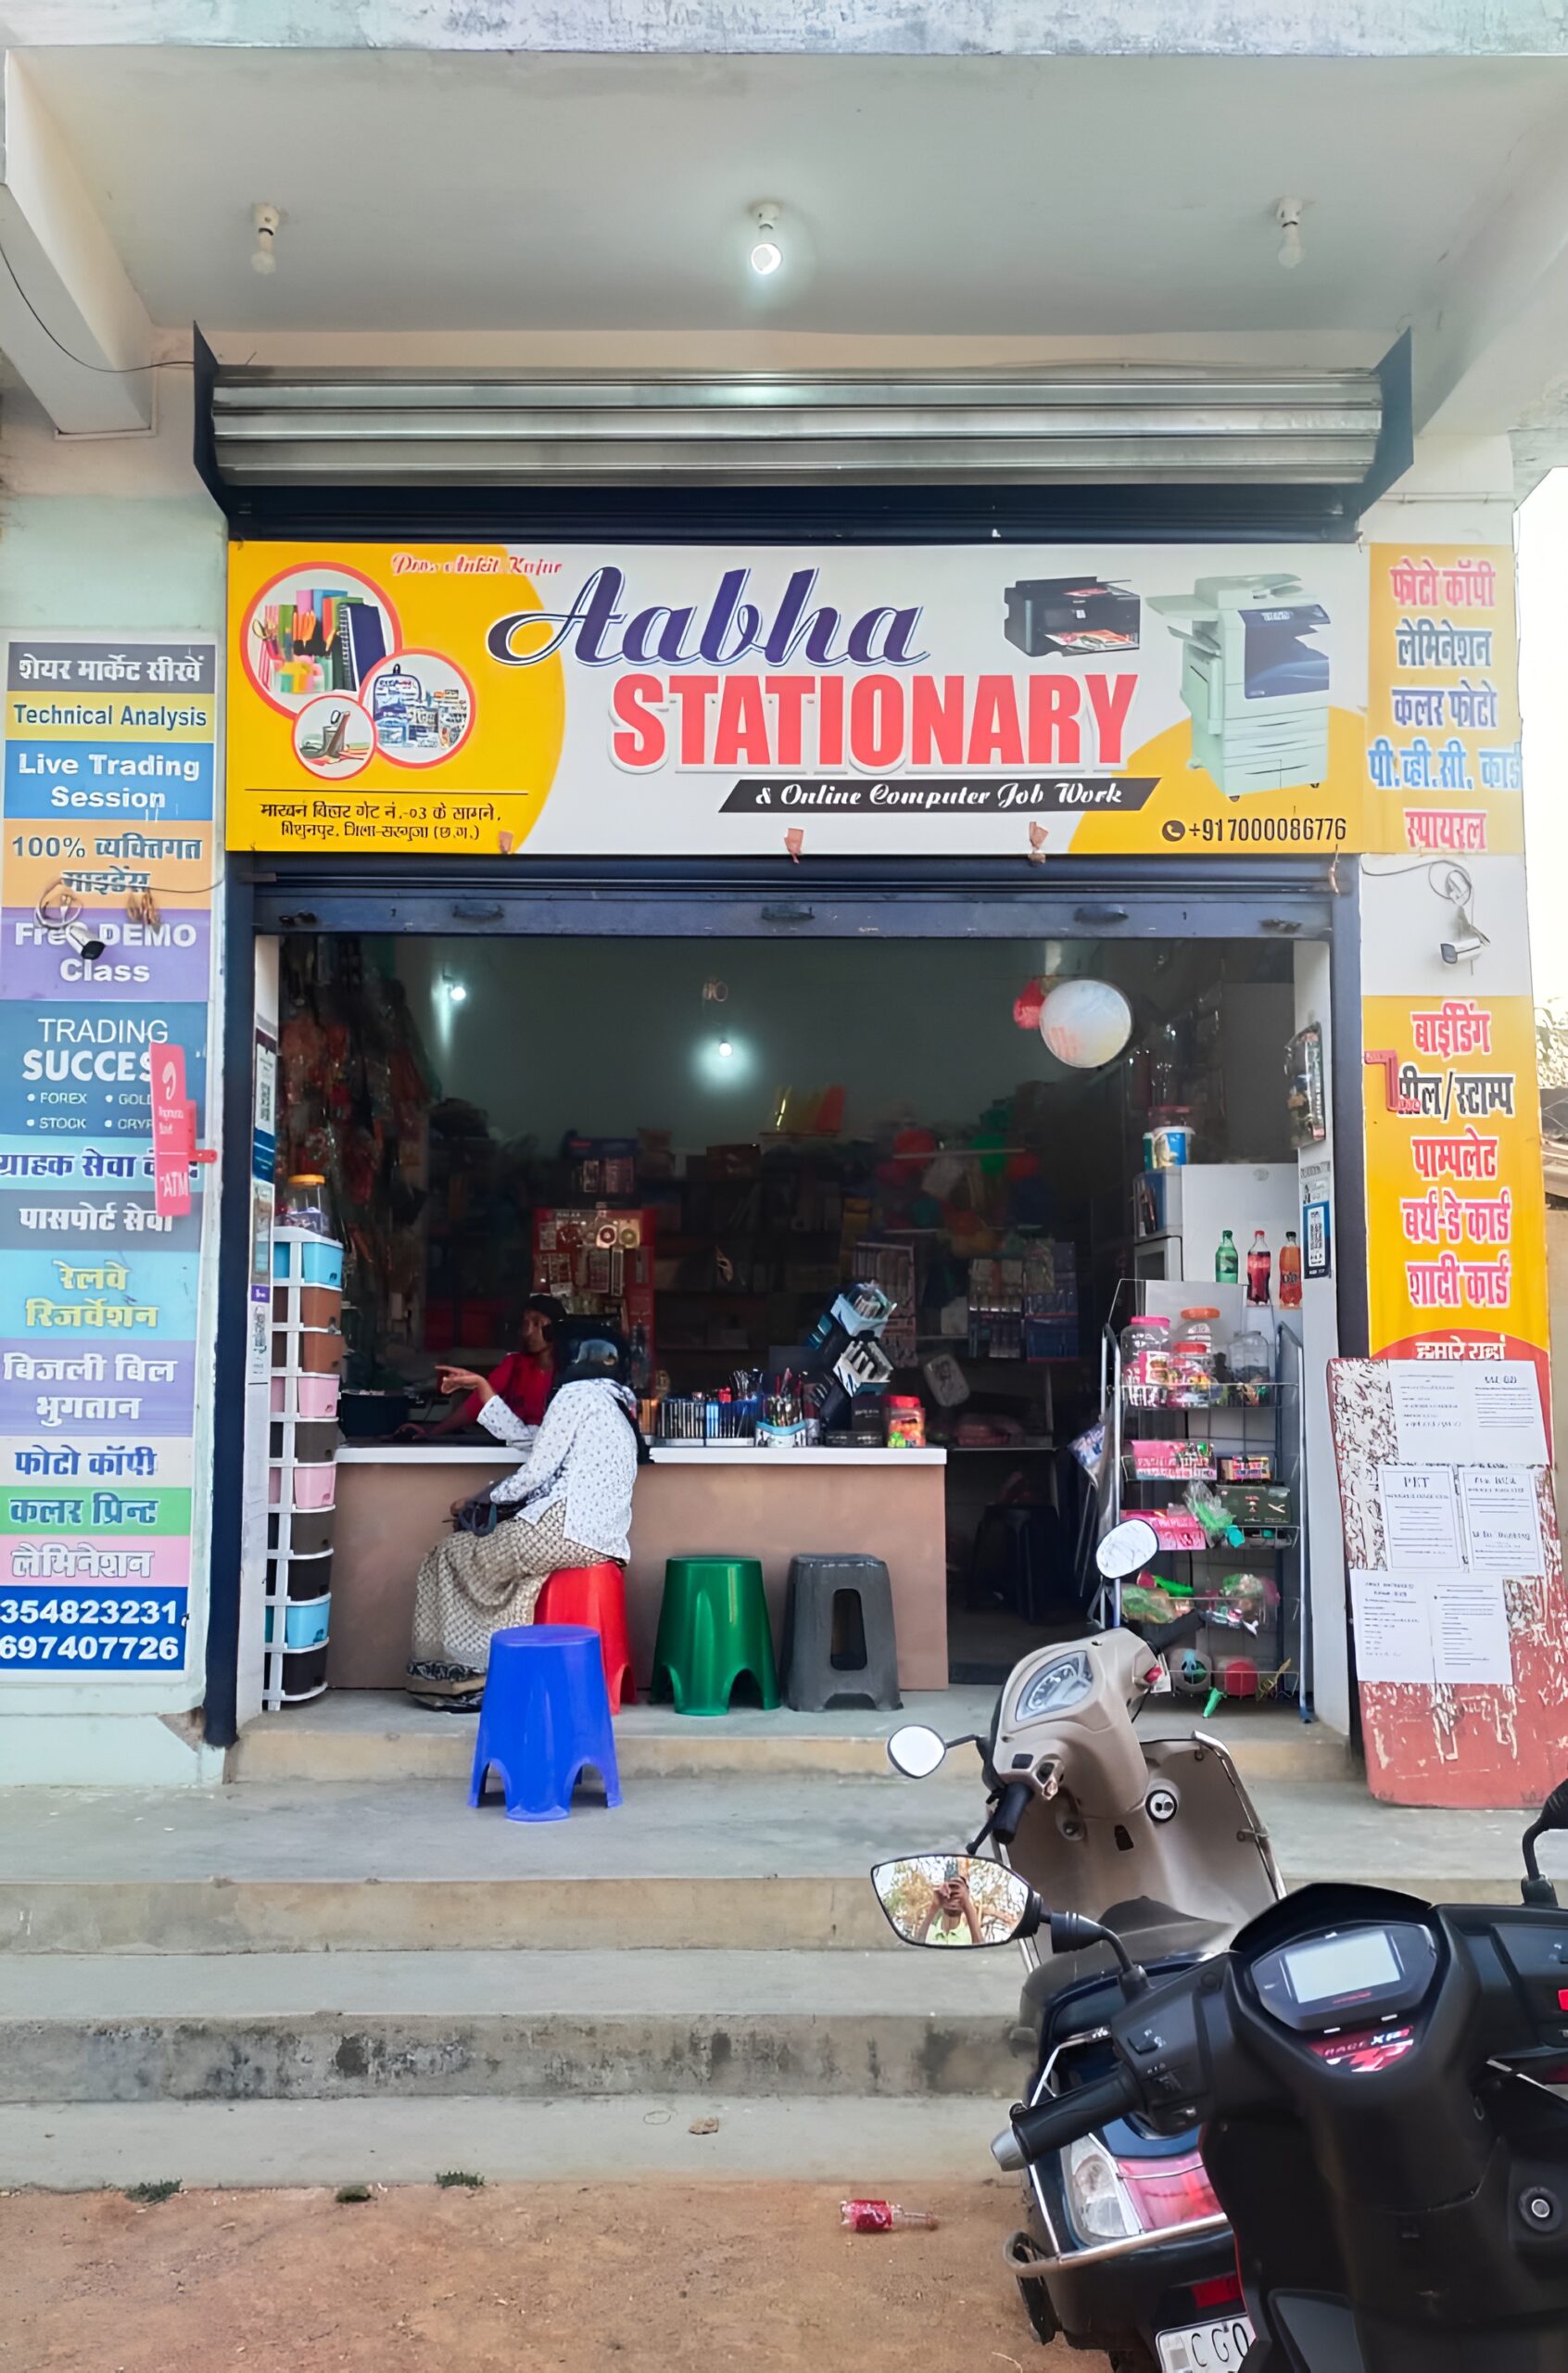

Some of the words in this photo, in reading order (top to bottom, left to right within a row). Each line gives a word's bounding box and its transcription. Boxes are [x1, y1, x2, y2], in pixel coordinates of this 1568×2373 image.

[445, 554, 499, 573] Ankit
[1390, 559, 1438, 606] फोटो
[1443, 561, 1495, 606] कॉपी
[487, 566, 930, 666] Aabha
[1397, 619, 1491, 666] लेमिनेशन
[19, 654, 70, 680] शेयर
[78, 654, 140, 680] मार्केट
[147, 655, 204, 682] सीखें
[13, 704, 112, 726] Technical
[120, 705, 207, 730] Analysis
[1392, 690, 1444, 726] कलर
[1448, 680, 1498, 727] फोटो
[612, 673, 1139, 769] STATIONARY
[19, 754, 79, 775] Live
[89, 755, 199, 780] Trading
[51, 786, 165, 808] Session
[355, 801, 380, 818] गेट
[433, 802, 447, 819] के
[755, 788, 772, 805] &
[780, 783, 861, 806] Online
[869, 783, 991, 809] Computer
[996, 782, 1044, 808] Job
[1054, 782, 1123, 805] Work
[1189, 818, 1347, 842] +917000086776
[1406, 813, 1486, 849] स्पायरल
[12, 836, 86, 858] 100%
[16, 921, 87, 946] Fre
[99, 922, 197, 947] DEMO
[60, 958, 150, 983] Class
[37, 1018, 169, 1044] TRADING
[22, 1049, 153, 1083] SUCCES
[40, 1092, 88, 1105] FOREX
[39, 1117, 87, 1129] STOCK
[118, 1118, 154, 1130] CRYP
[82, 1148, 137, 1178] सेवा
[1412, 1129, 1497, 1176] पाम्पलेट
[19, 1202, 117, 1231] पासपोर्ट
[123, 1203, 173, 1232] सेवा
[1466, 1190, 1511, 1240] कार्ड
[53, 1261, 130, 1290] रेलवे
[1409, 1254, 1460, 1303] शादी
[1464, 1254, 1510, 1304] कार्ड
[26, 1298, 158, 1328] रिजर्वेशन
[3, 1352, 107, 1382] बिजली
[115, 1353, 178, 1382] बिल
[36, 1397, 143, 1427] भुगतान
[15, 1445, 81, 1476] फोटो
[89, 1445, 157, 1476] कॉपी
[10, 1499, 83, 1524] कलर
[93, 1492, 158, 1525] प्रिन्ट
[11, 1543, 155, 1578] लेमिनेशन
